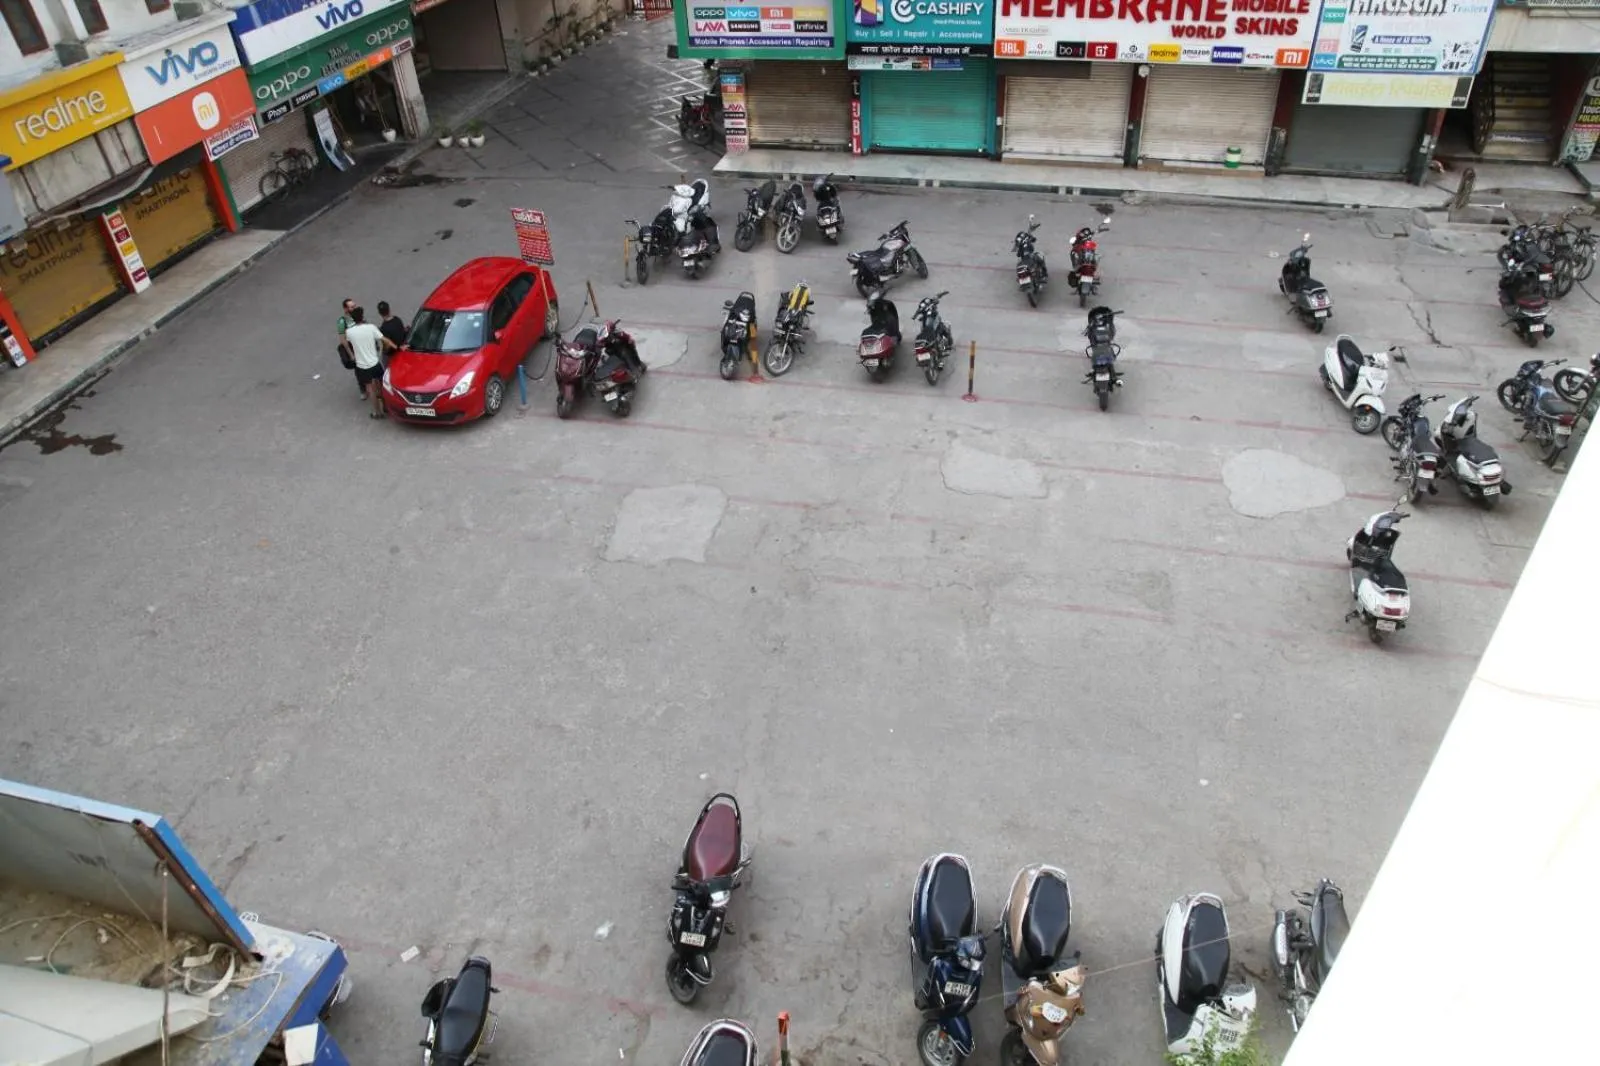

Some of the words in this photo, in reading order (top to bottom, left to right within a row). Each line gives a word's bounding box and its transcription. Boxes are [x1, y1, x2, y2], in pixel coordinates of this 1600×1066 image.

[728, 8, 757, 17] vivo
[916, 2, 983, 15] CASHIFY
[1001, 0, 1228, 24] MEMBRANE
[1232, 0, 1309, 13] MOBILE
[316, 0, 364, 30] vivo
[366, 18, 409, 46] oppo
[695, 21, 726, 32] LAVA
[796, 23, 824, 31] Infinix
[1171, 25, 1226, 39] WORLD
[1235, 17, 1299, 36] SKINS
[855, 31, 869, 39] Buy
[880, 30, 893, 38] Sell
[904, 31, 928, 39] Repair
[694, 38, 718, 46] Mobile
[719, 38, 746, 46] Phones
[750, 38, 792, 46] Accessories
[795, 38, 830, 47] Repairing
[1001, 42, 1020, 54] JBL
[1213, 51, 1242, 59] SAMSUNG
[144, 41, 219, 85] vivo
[256, 65, 312, 100] oppo
[14, 89, 108, 145] realme
[267, 107, 287, 121] iPhone
[136, 186, 190, 220] SMARTPHONE
